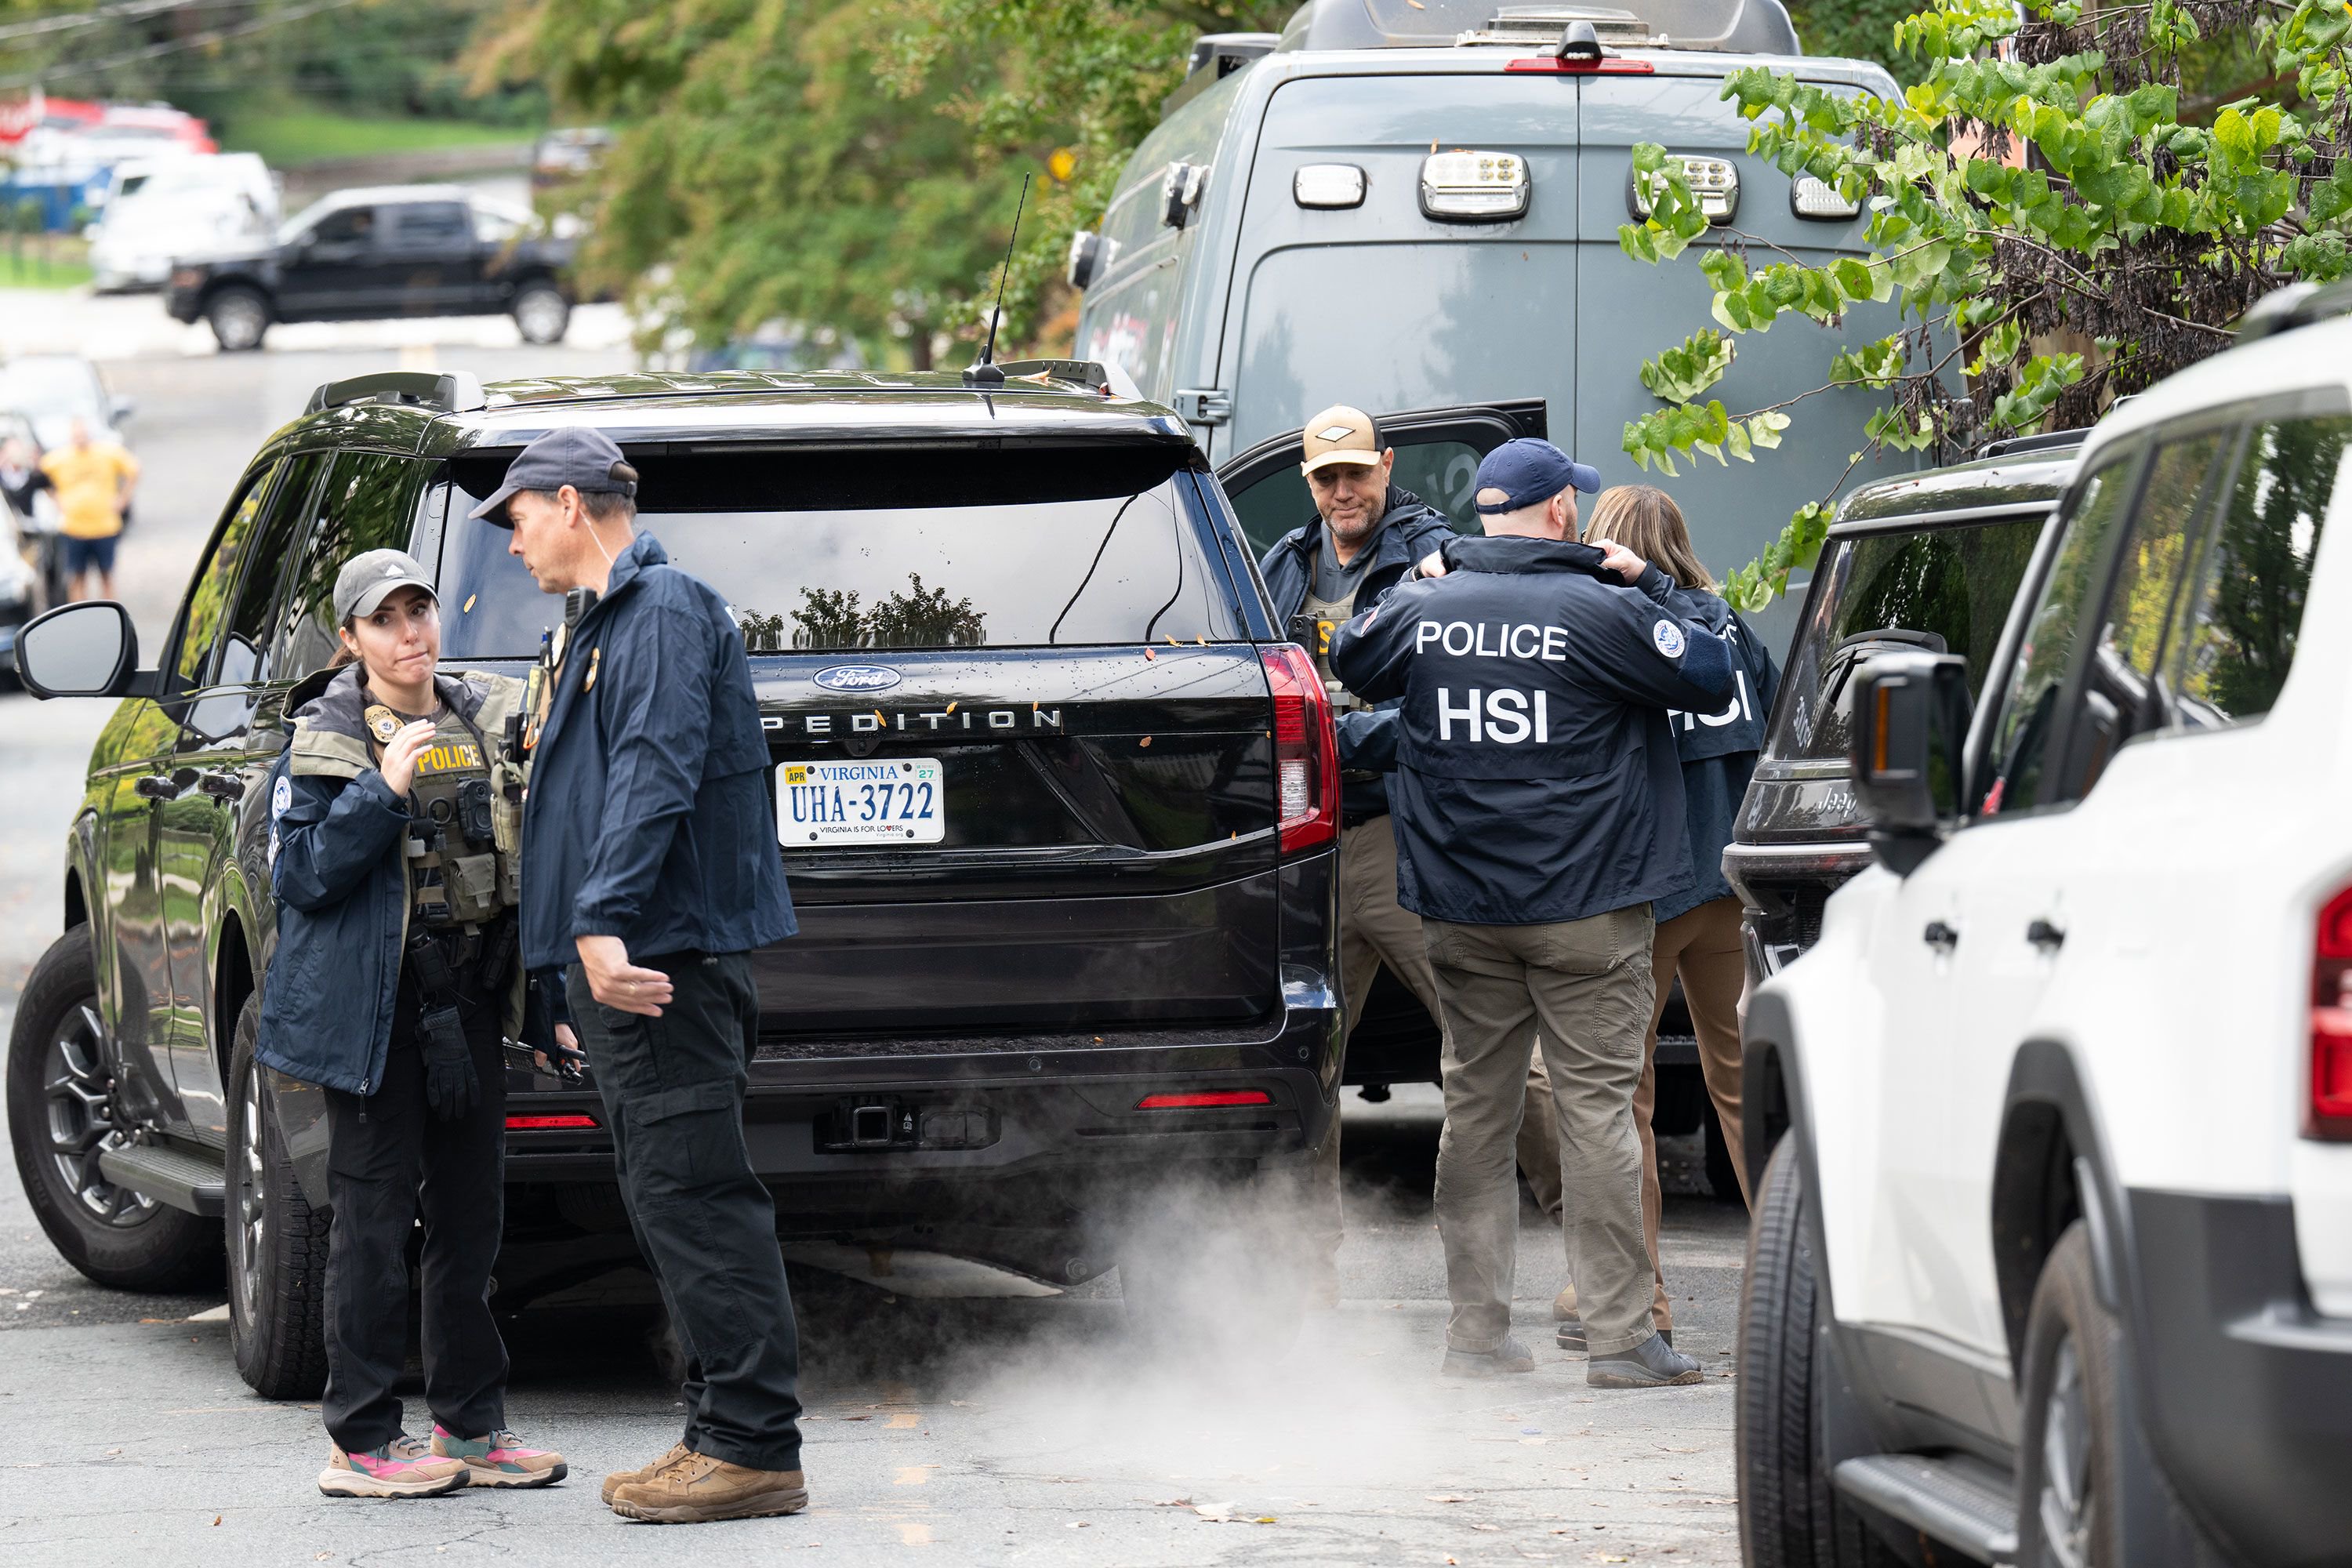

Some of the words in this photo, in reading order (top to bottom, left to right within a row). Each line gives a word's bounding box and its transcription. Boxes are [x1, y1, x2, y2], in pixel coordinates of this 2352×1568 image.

[1416, 621, 1569, 661] POLICE
[832, 668, 883, 687] Ford
[760, 710, 1061, 733] PEDITION
[1437, 688, 1548, 744] HSI
[417, 745, 481, 773] POLICE
[789, 771, 805, 782] APR
[820, 765, 898, 781] VIRGINIA
[918, 769, 935, 779] 27
[790, 782, 934, 822] UHA-3722
